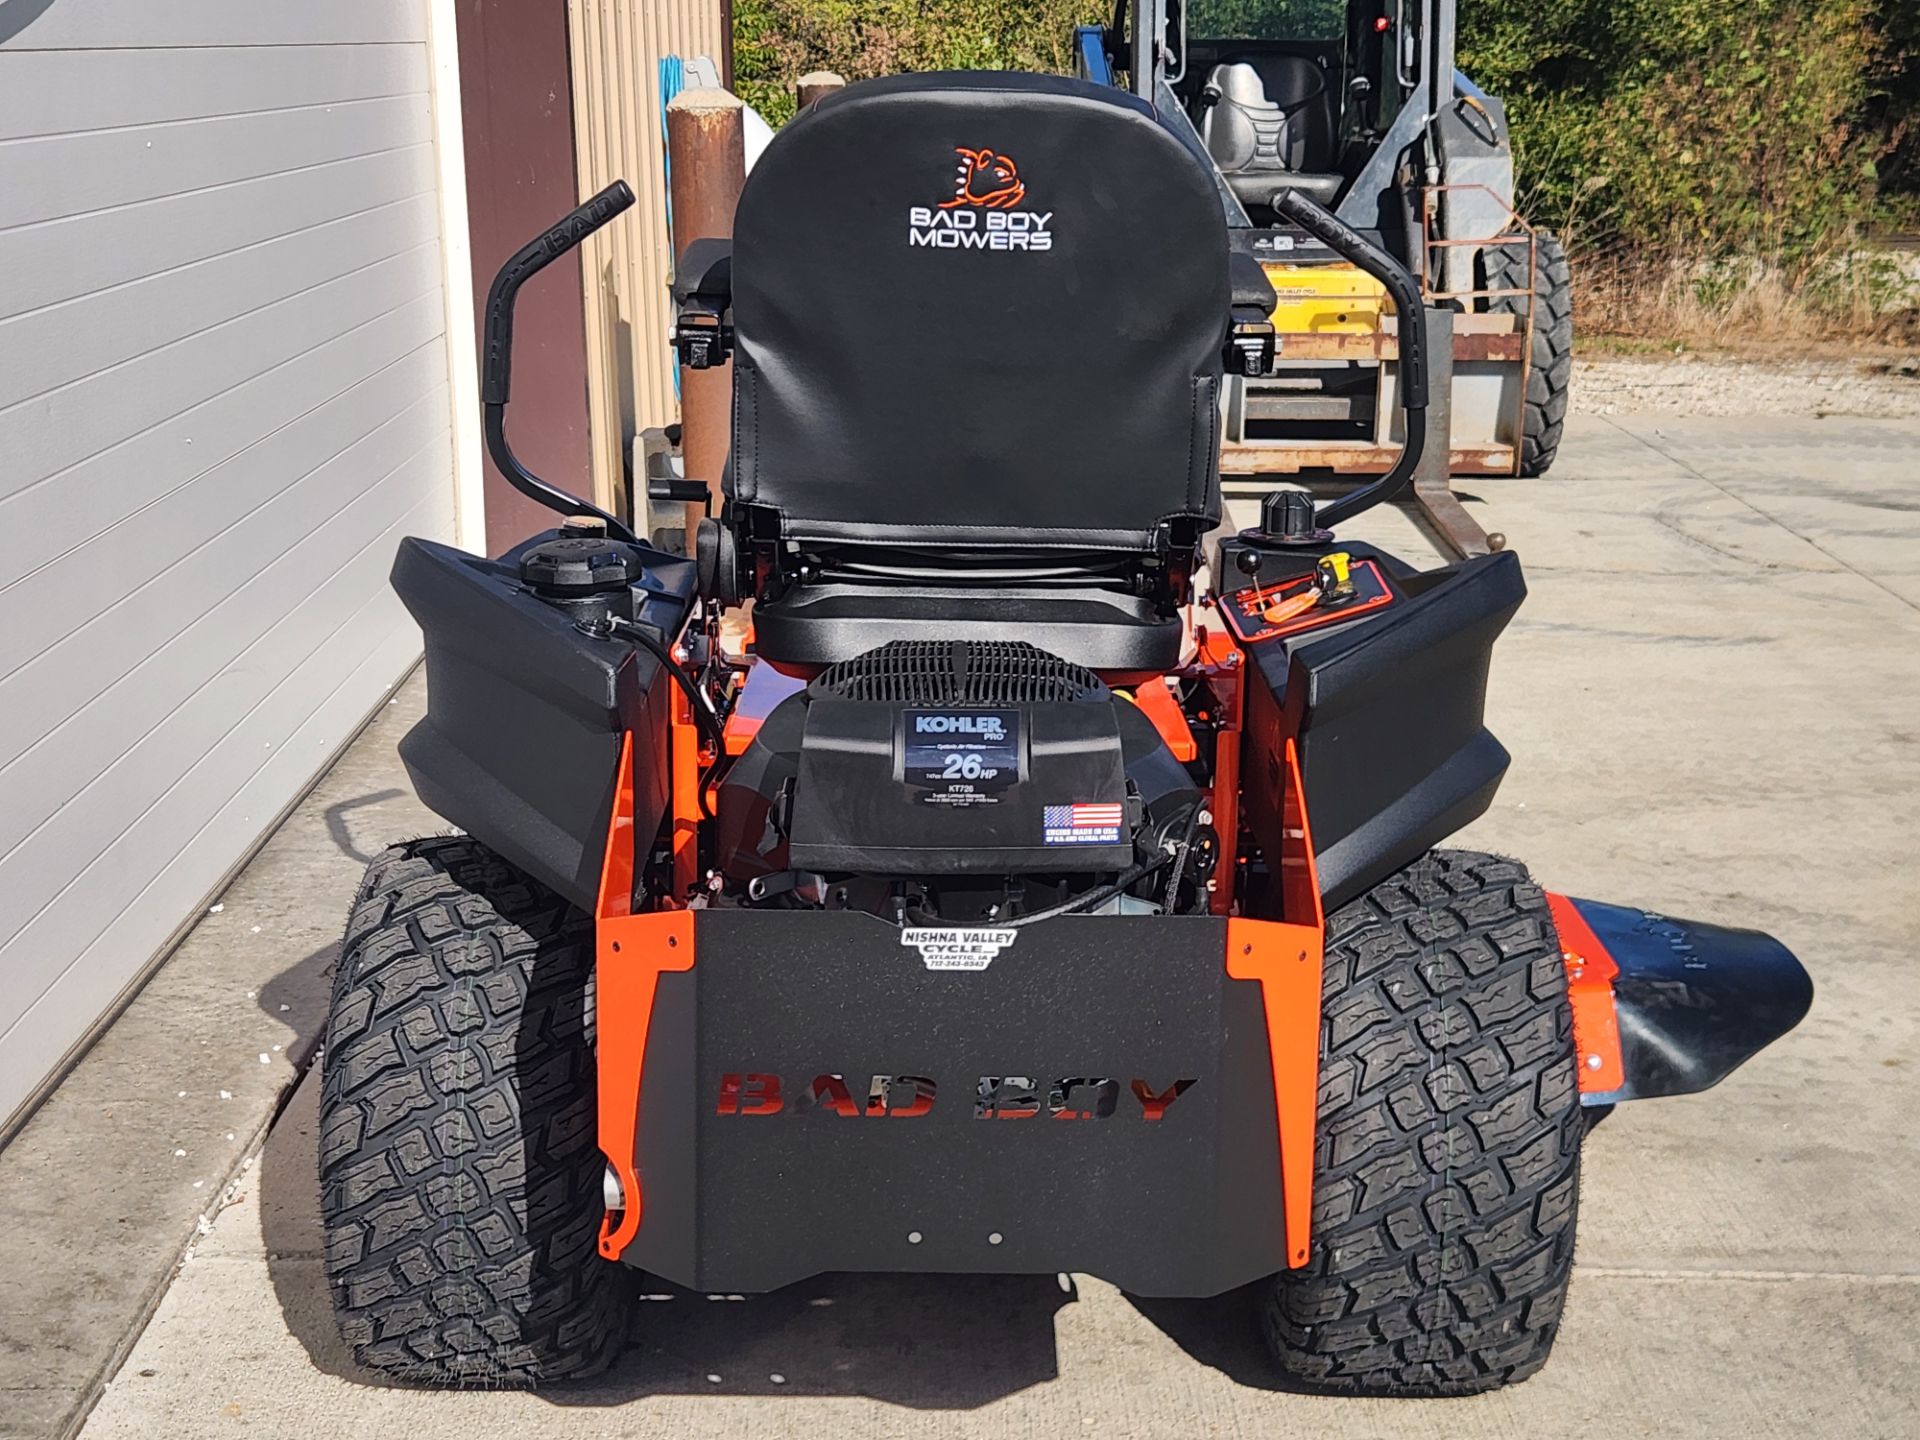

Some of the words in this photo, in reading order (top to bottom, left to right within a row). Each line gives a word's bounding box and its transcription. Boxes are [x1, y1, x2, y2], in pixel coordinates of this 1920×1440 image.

[909, 207, 977, 229] BAD
[986, 211, 1053, 231] BOY
[909, 227, 1053, 251] MOWERS
[916, 716, 1003, 733] KOHLER
[983, 733, 1005, 741] PRO
[942, 753, 983, 780] 26
[980, 768, 998, 780] HP
[904, 932, 957, 943] NISHNA
[963, 932, 1013, 943] VALLEY
[923, 945, 983, 953] CYCLE
[715, 1073, 938, 1118] BAD
[972, 1075, 1199, 1121] BOY
